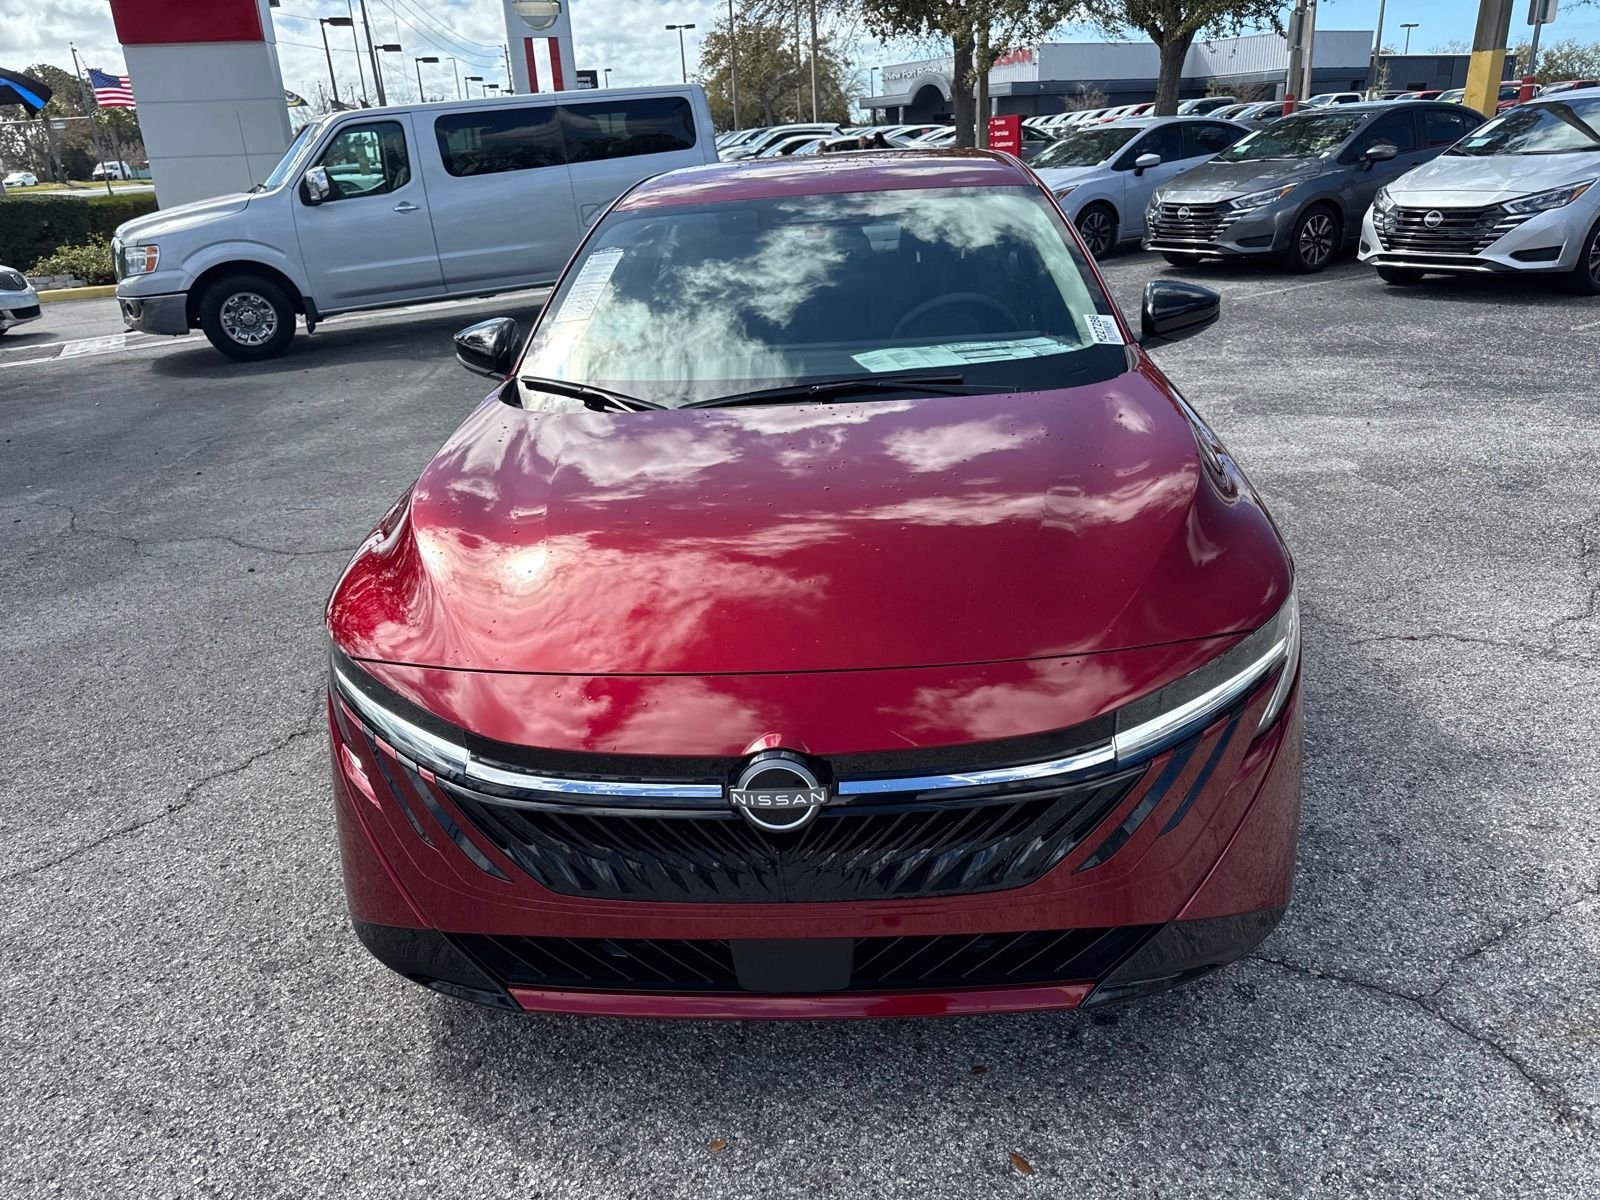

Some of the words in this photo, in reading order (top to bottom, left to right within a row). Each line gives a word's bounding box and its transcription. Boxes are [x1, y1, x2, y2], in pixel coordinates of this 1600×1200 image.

[886, 72, 902, 81] New
[903, 70, 917, 79] Port
[732, 790, 825, 806] NISSAN
